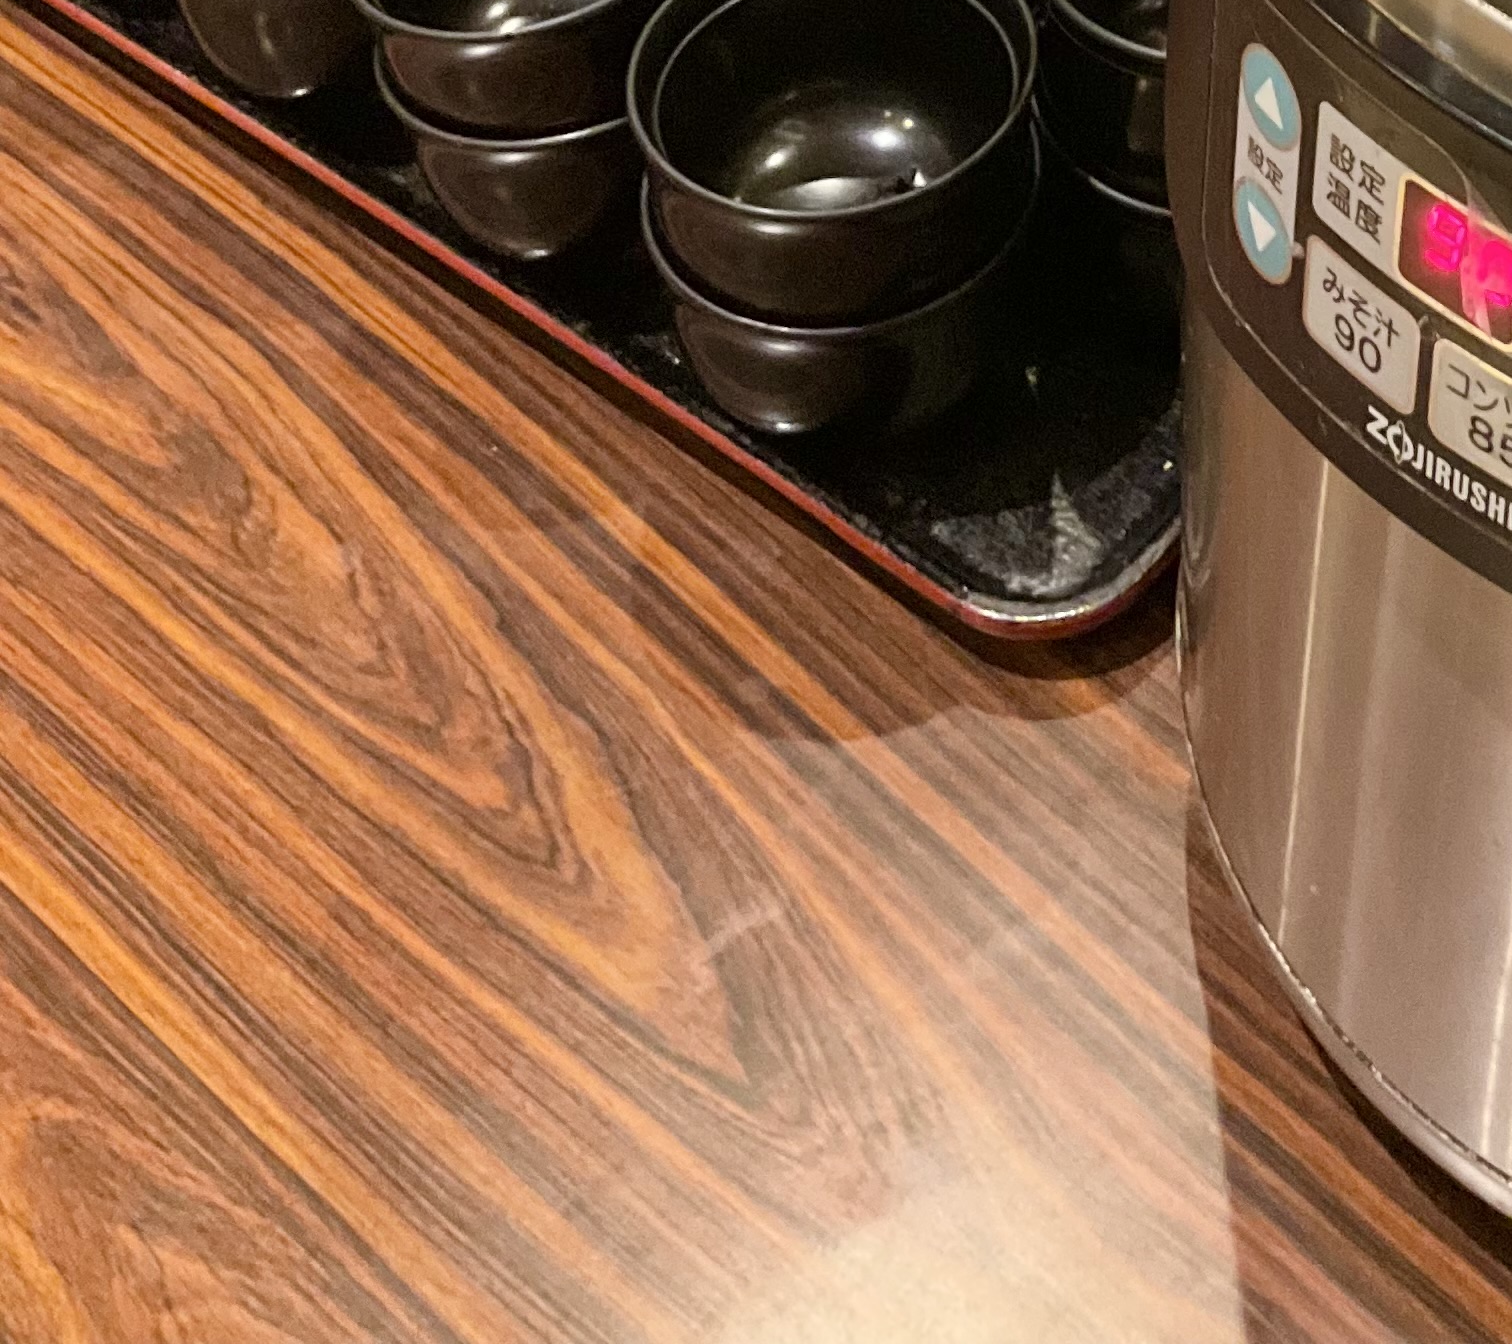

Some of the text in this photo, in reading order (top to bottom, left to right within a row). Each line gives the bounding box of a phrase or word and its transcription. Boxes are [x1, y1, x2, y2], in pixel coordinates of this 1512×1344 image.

[1248, 135, 1283, 195] 設定
[1329, 133, 1386, 205] 設定
[1326, 171, 1382, 245] 温度
[1322, 267, 1400, 349] みそ汁
[1334, 313, 1382, 374] 90
